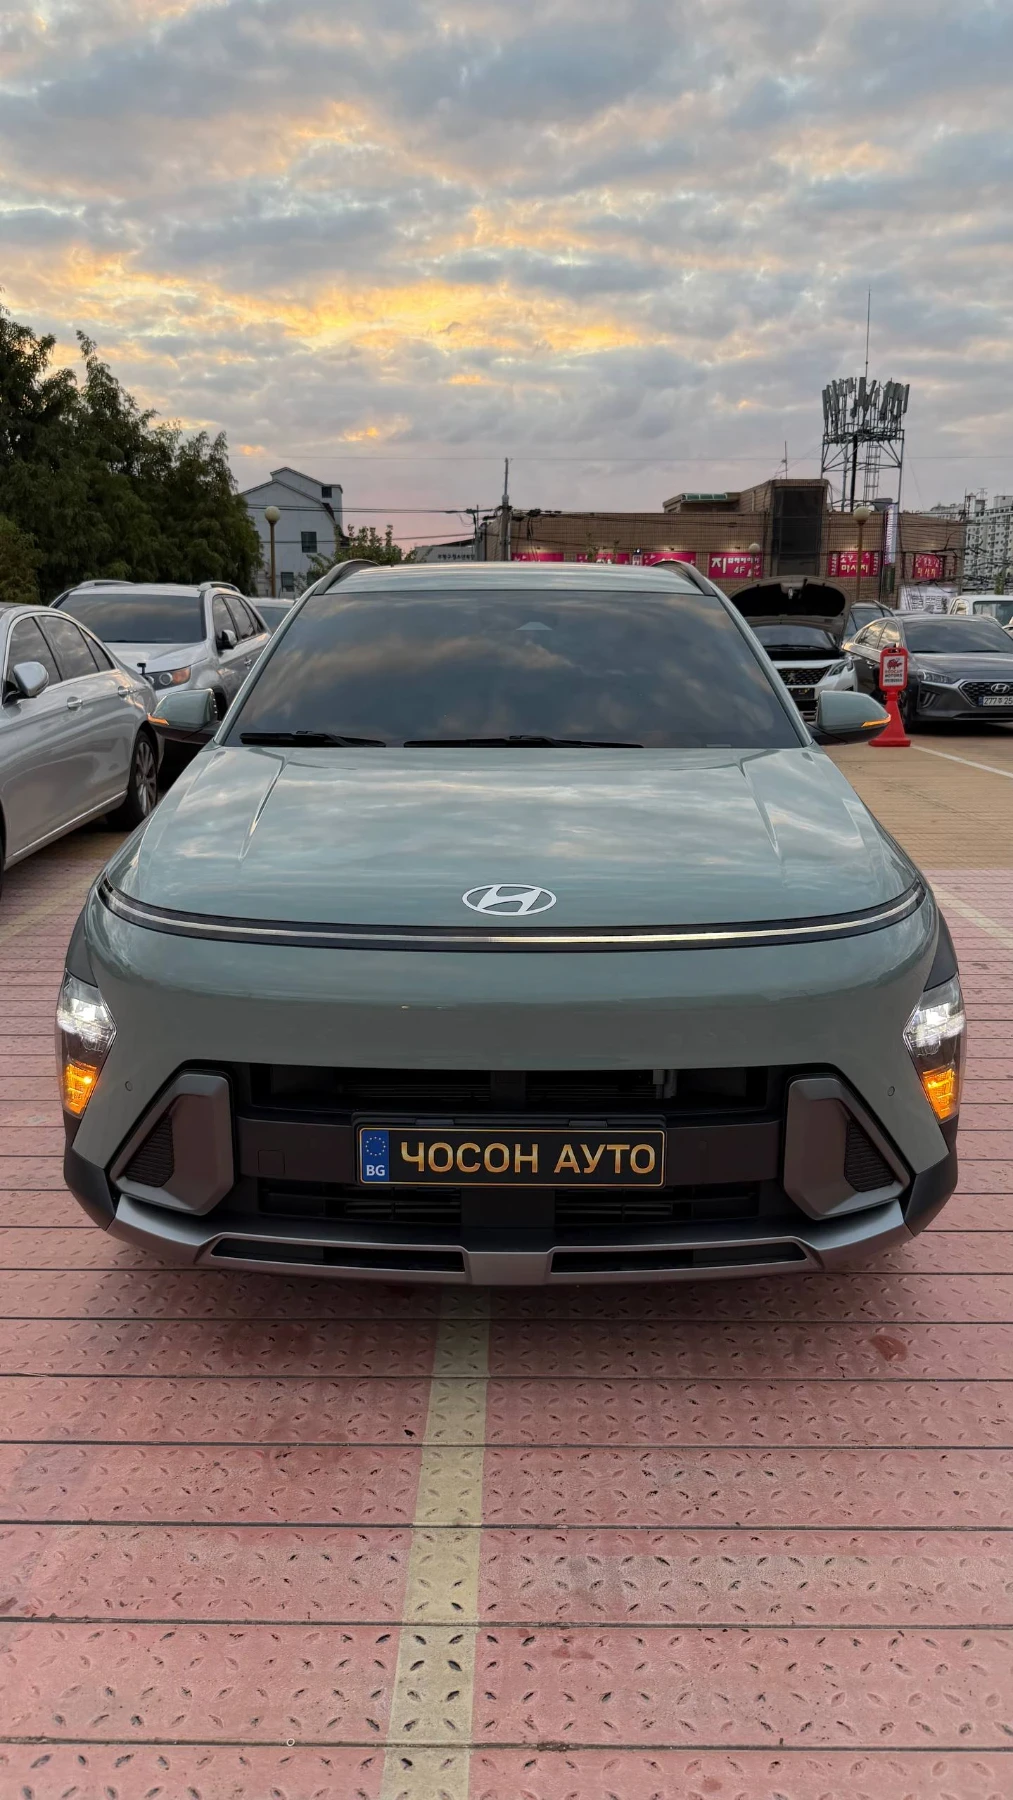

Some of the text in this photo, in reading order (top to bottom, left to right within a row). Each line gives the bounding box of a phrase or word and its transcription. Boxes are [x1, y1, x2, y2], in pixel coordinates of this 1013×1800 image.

[734, 566, 745, 574] 4F
[400, 1141, 656, 1174] ЧОСОН АУТО
[366, 1164, 386, 1177] BG
